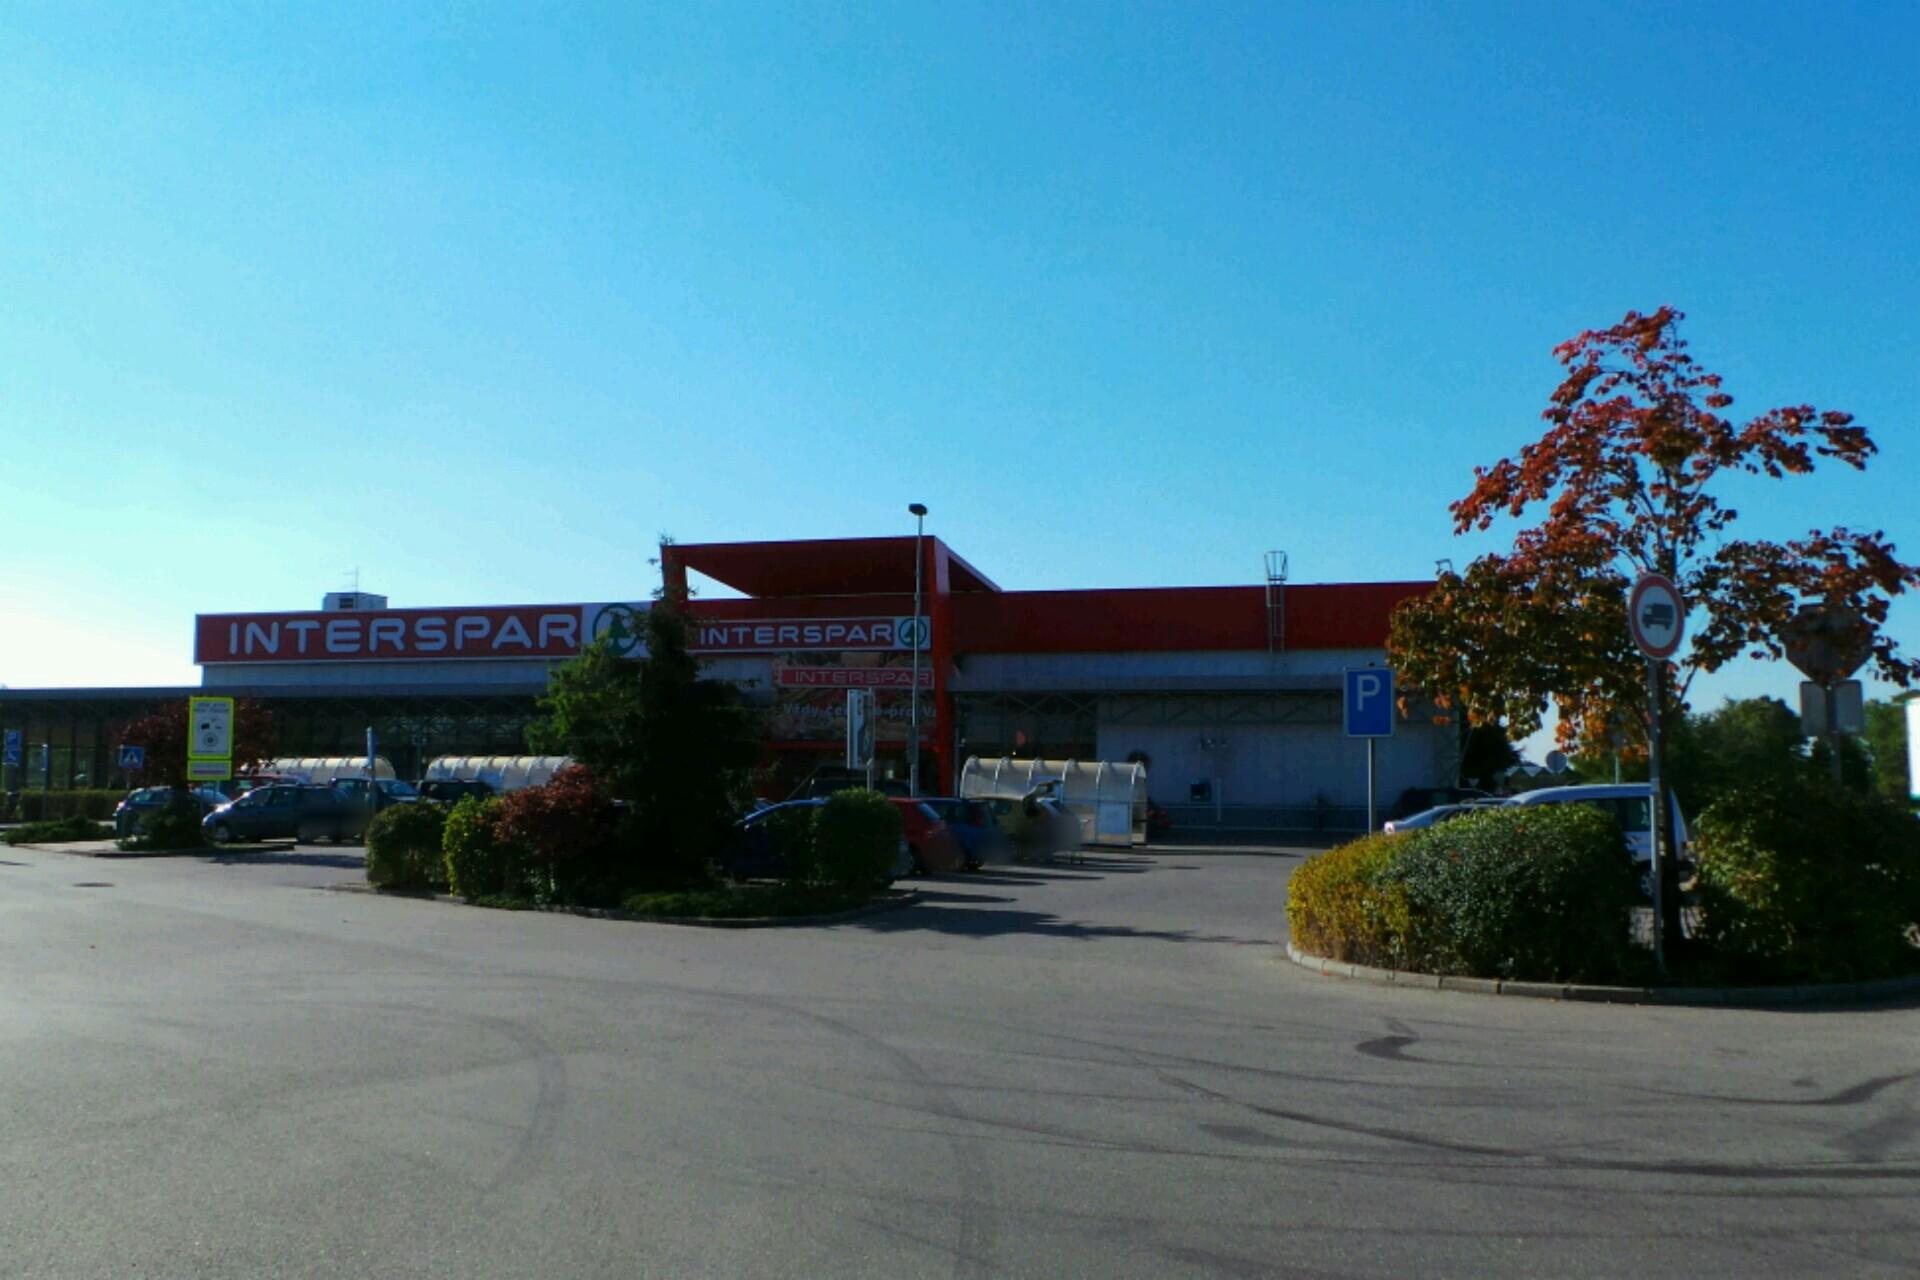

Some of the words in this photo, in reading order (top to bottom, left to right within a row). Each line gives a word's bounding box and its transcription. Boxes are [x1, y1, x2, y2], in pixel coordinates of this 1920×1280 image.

[229, 613, 578, 655] INTERSPAR
[700, 624, 894, 645] INTERSPAR
[794, 670, 930, 686] INTERSPAR
[1357, 674, 1381, 712] P
